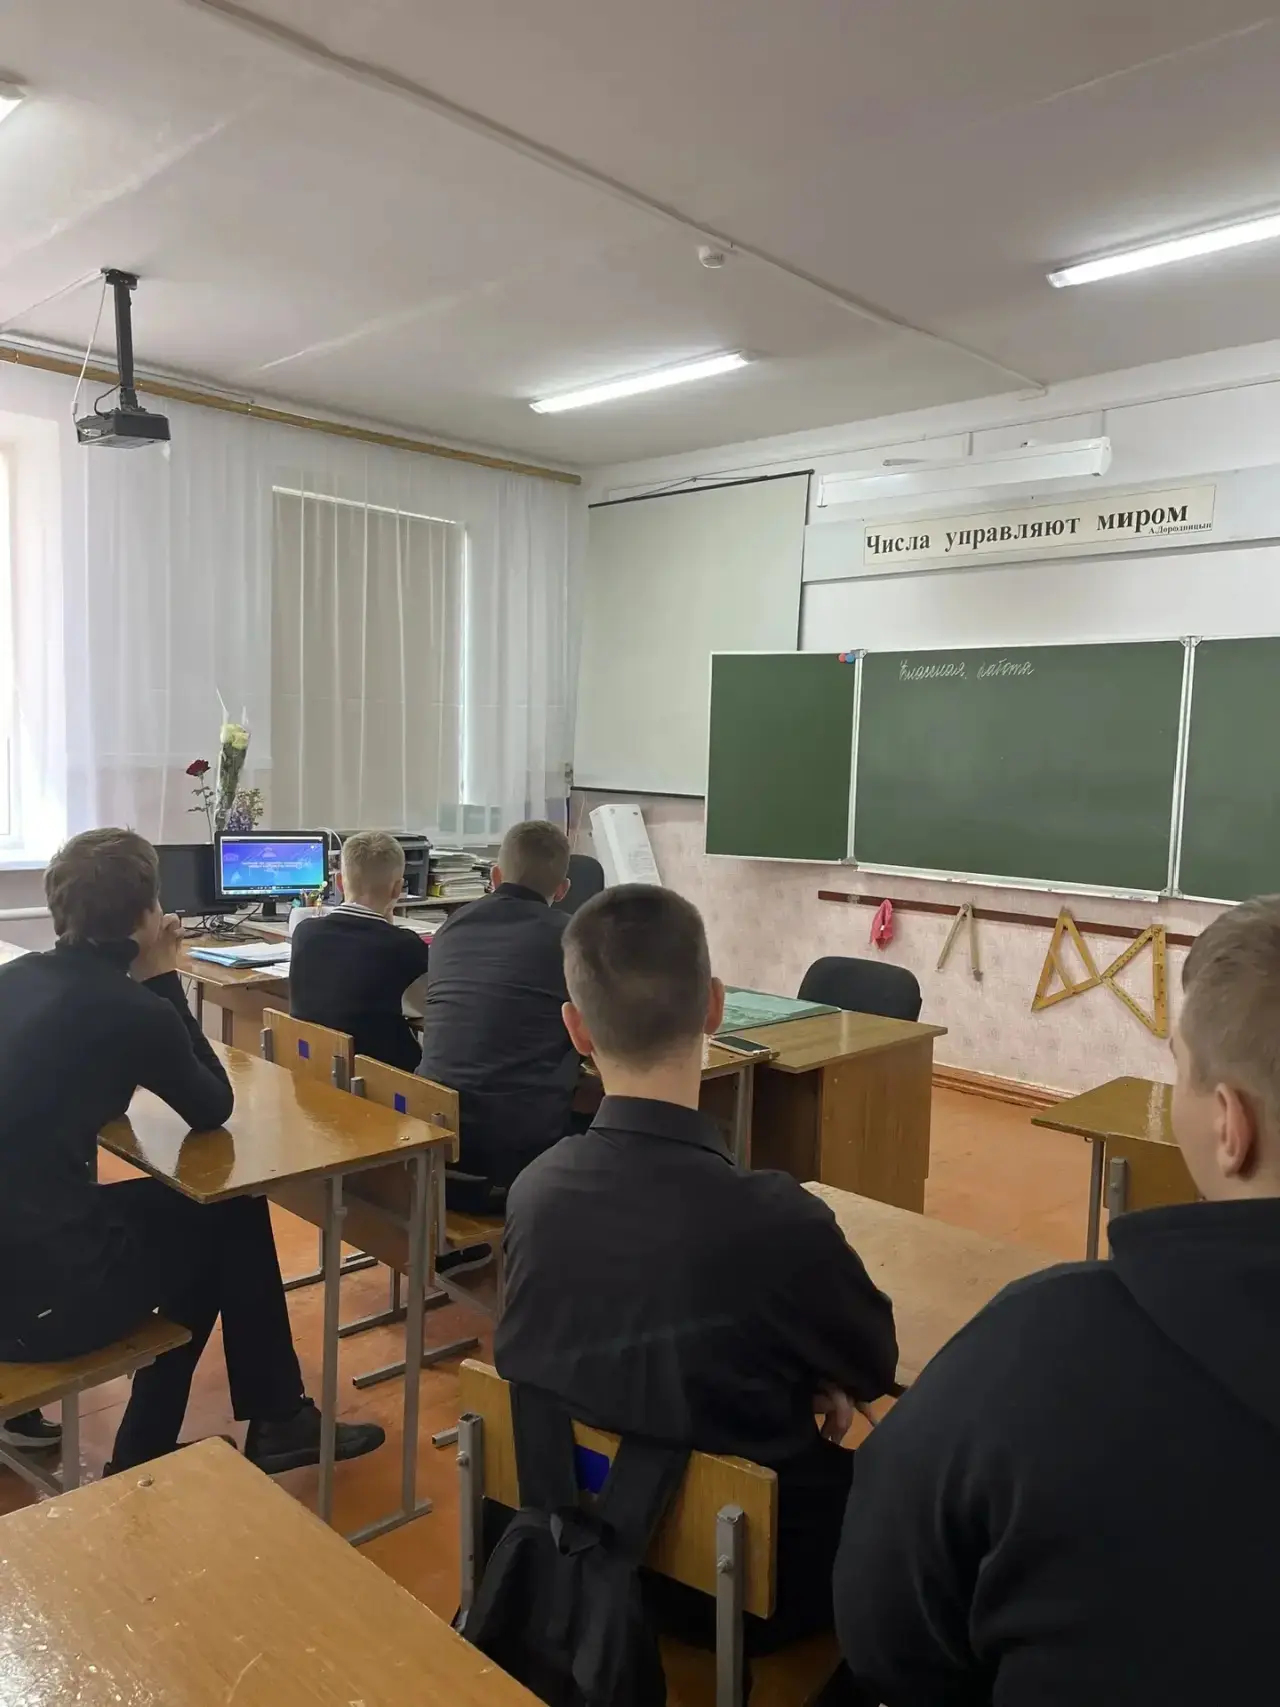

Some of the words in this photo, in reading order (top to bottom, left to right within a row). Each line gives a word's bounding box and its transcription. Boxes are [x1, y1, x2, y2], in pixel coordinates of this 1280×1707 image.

[866, 534, 930, 555] Числа
[944, 517, 1080, 552] управляют
[1097, 504, 1188, 533] миром
